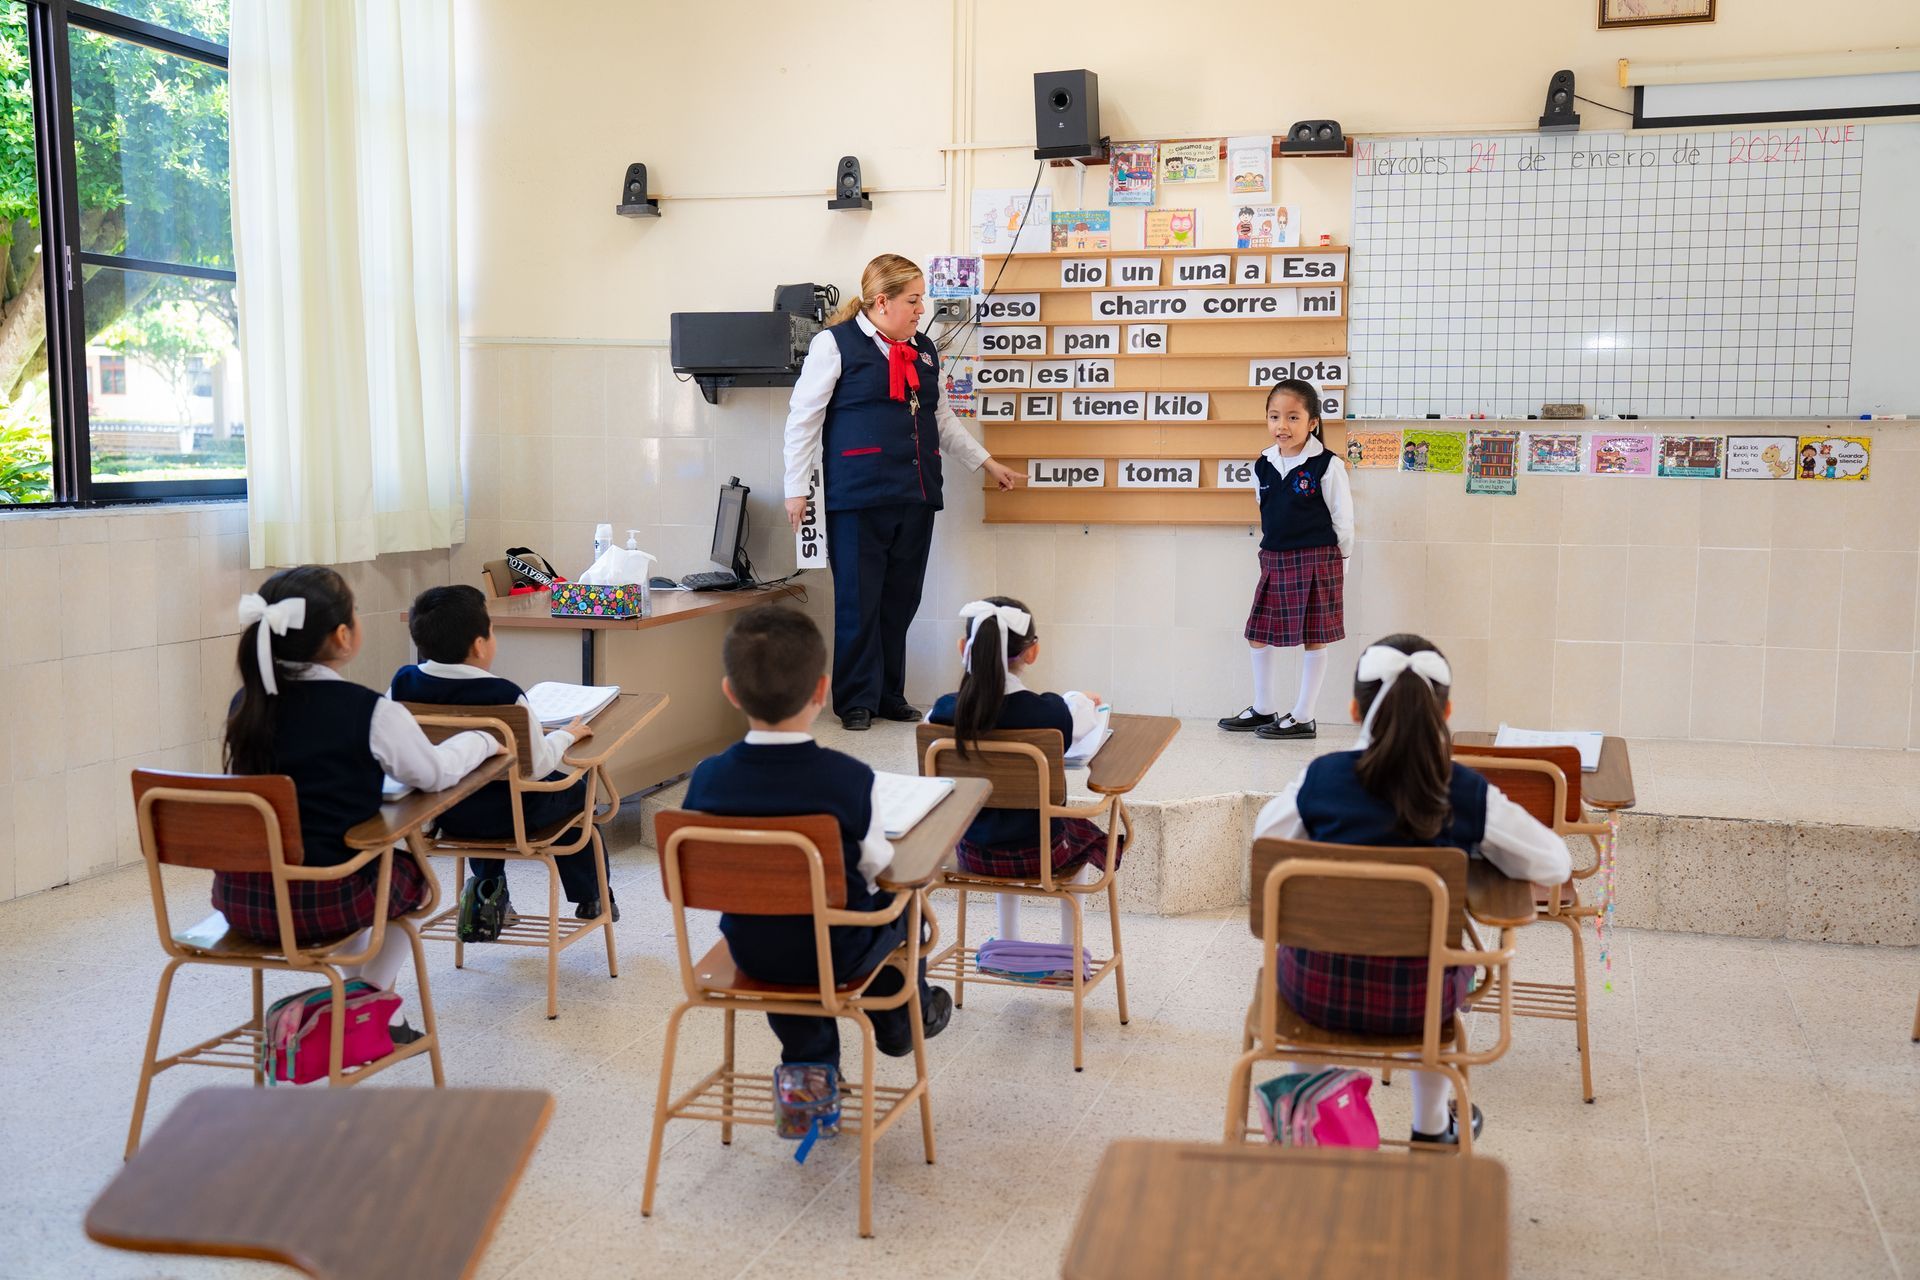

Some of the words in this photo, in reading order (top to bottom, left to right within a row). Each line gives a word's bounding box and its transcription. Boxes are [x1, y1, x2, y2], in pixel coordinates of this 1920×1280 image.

[1357, 142, 1448, 176] Miércoles
[1467, 143, 1496, 173] 24
[1518, 146, 1546, 171] de
[1572, 151, 1655, 169] enero
[1673, 138, 1701, 166] de
[1064, 263, 1102, 283] dio
[1122, 263, 1154, 281] un
[1180, 262, 1226, 280] una
[1244, 263, 1260, 279] a
[1283, 258, 1336, 278] Esa
[976, 299, 1036, 322] peso
[1100, 296, 1187, 315] charro
[1203, 295, 1277, 313] corre
[1303, 291, 1335, 312] mi
[983, 333, 1041, 354] sopa
[1064, 332, 1109, 352] pan
[1132, 329, 1161, 349] de
[978, 368, 1024, 383] con
[1037, 367, 1068, 383] es
[1078, 362, 1109, 383] tía
[1255, 361, 1342, 385] pelota
[982, 398, 1014, 416] La
[1027, 397, 1053, 415] El
[1072, 396, 1139, 415] tiene
[1155, 396, 1202, 415] kilo
[1035, 463, 1098, 486] Lupe
[1126, 464, 1193, 482] toma
[1225, 462, 1251, 481] té
